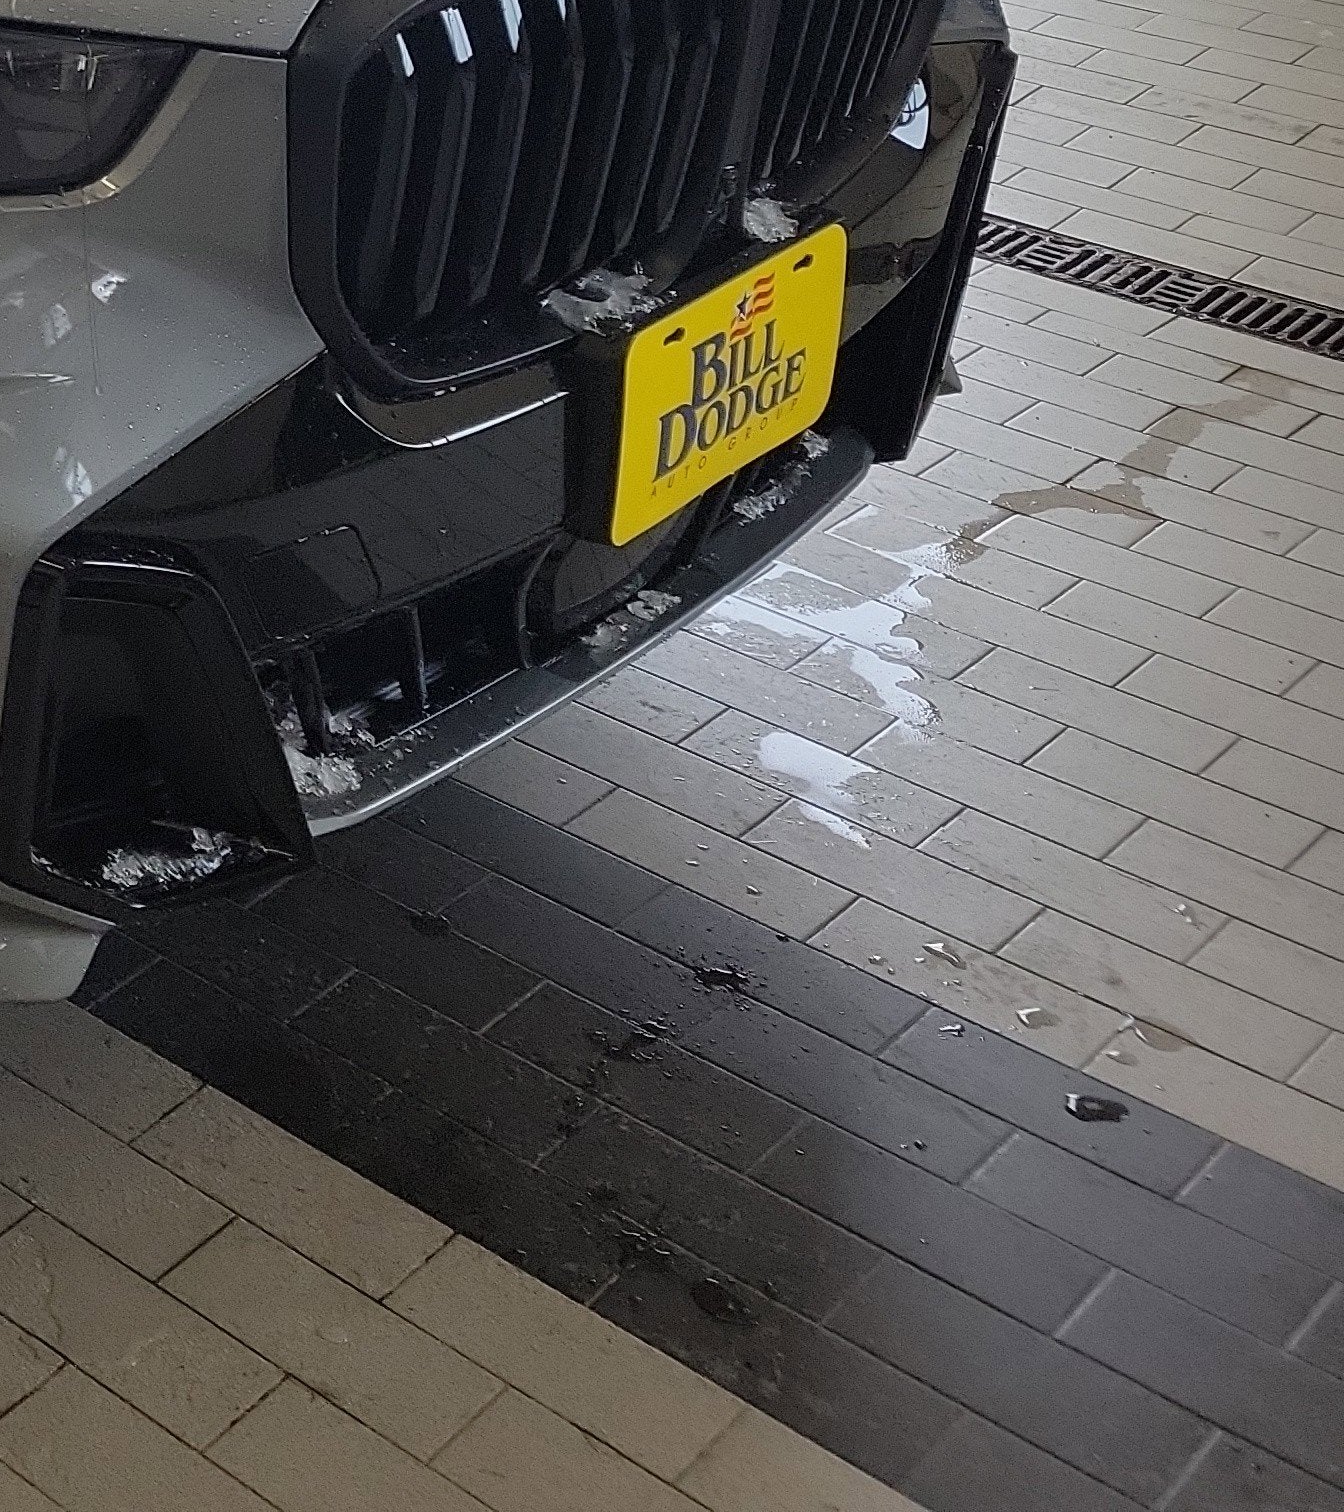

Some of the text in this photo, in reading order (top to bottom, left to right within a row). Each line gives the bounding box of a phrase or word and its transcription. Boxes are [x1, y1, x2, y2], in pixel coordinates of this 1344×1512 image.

[691, 318, 786, 409] BILL
[650, 397, 799, 498] AUTO GROUP
[652, 347, 807, 483] DODGE
